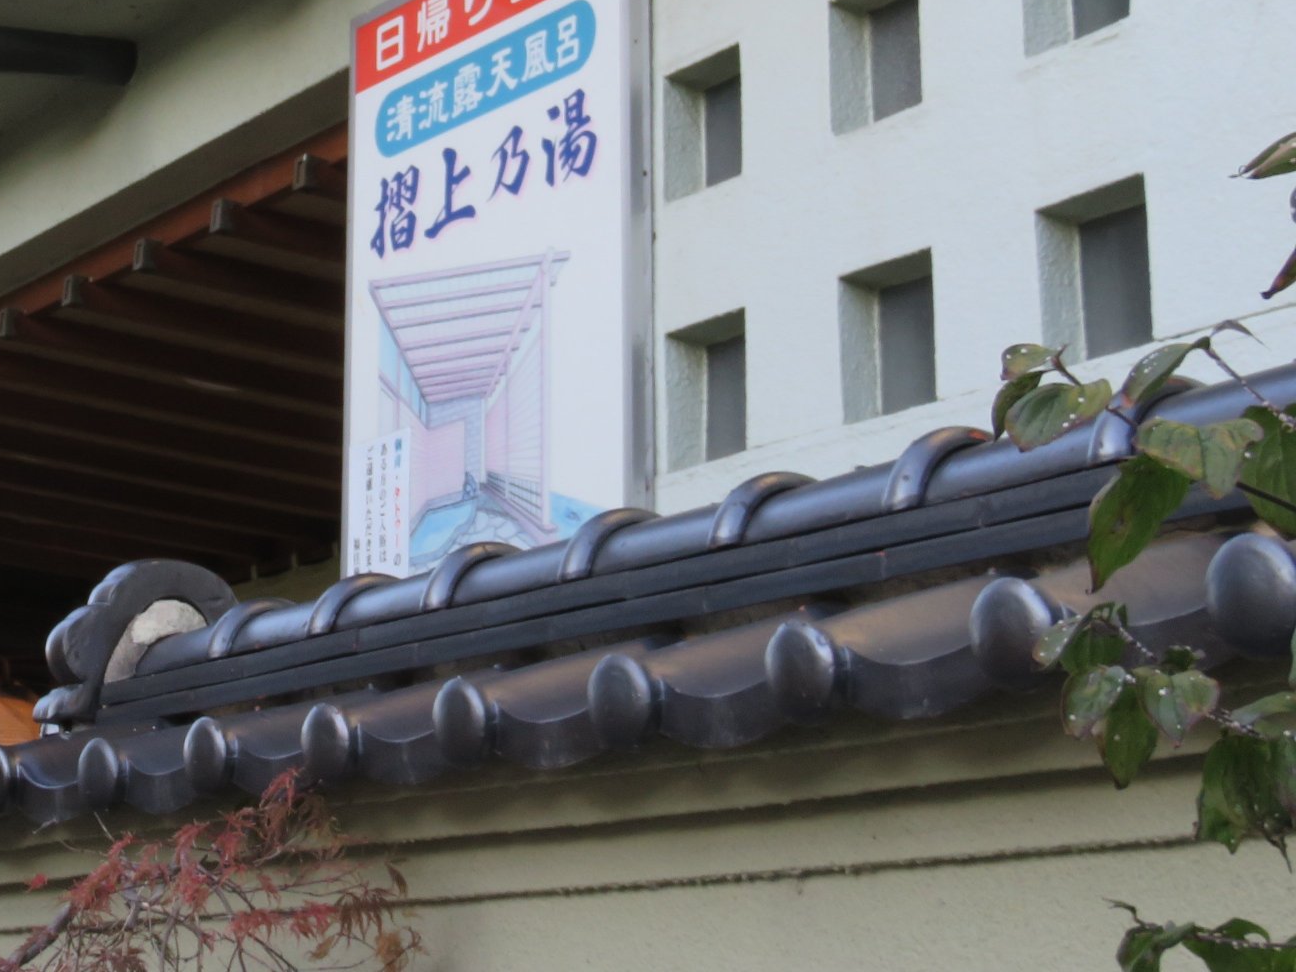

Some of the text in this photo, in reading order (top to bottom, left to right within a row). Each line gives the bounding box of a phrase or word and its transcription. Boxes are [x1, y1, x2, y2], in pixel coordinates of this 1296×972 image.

[386, 14, 581, 144] 清流露天風呂
[370, 88, 598, 260] 摺上乃湯
